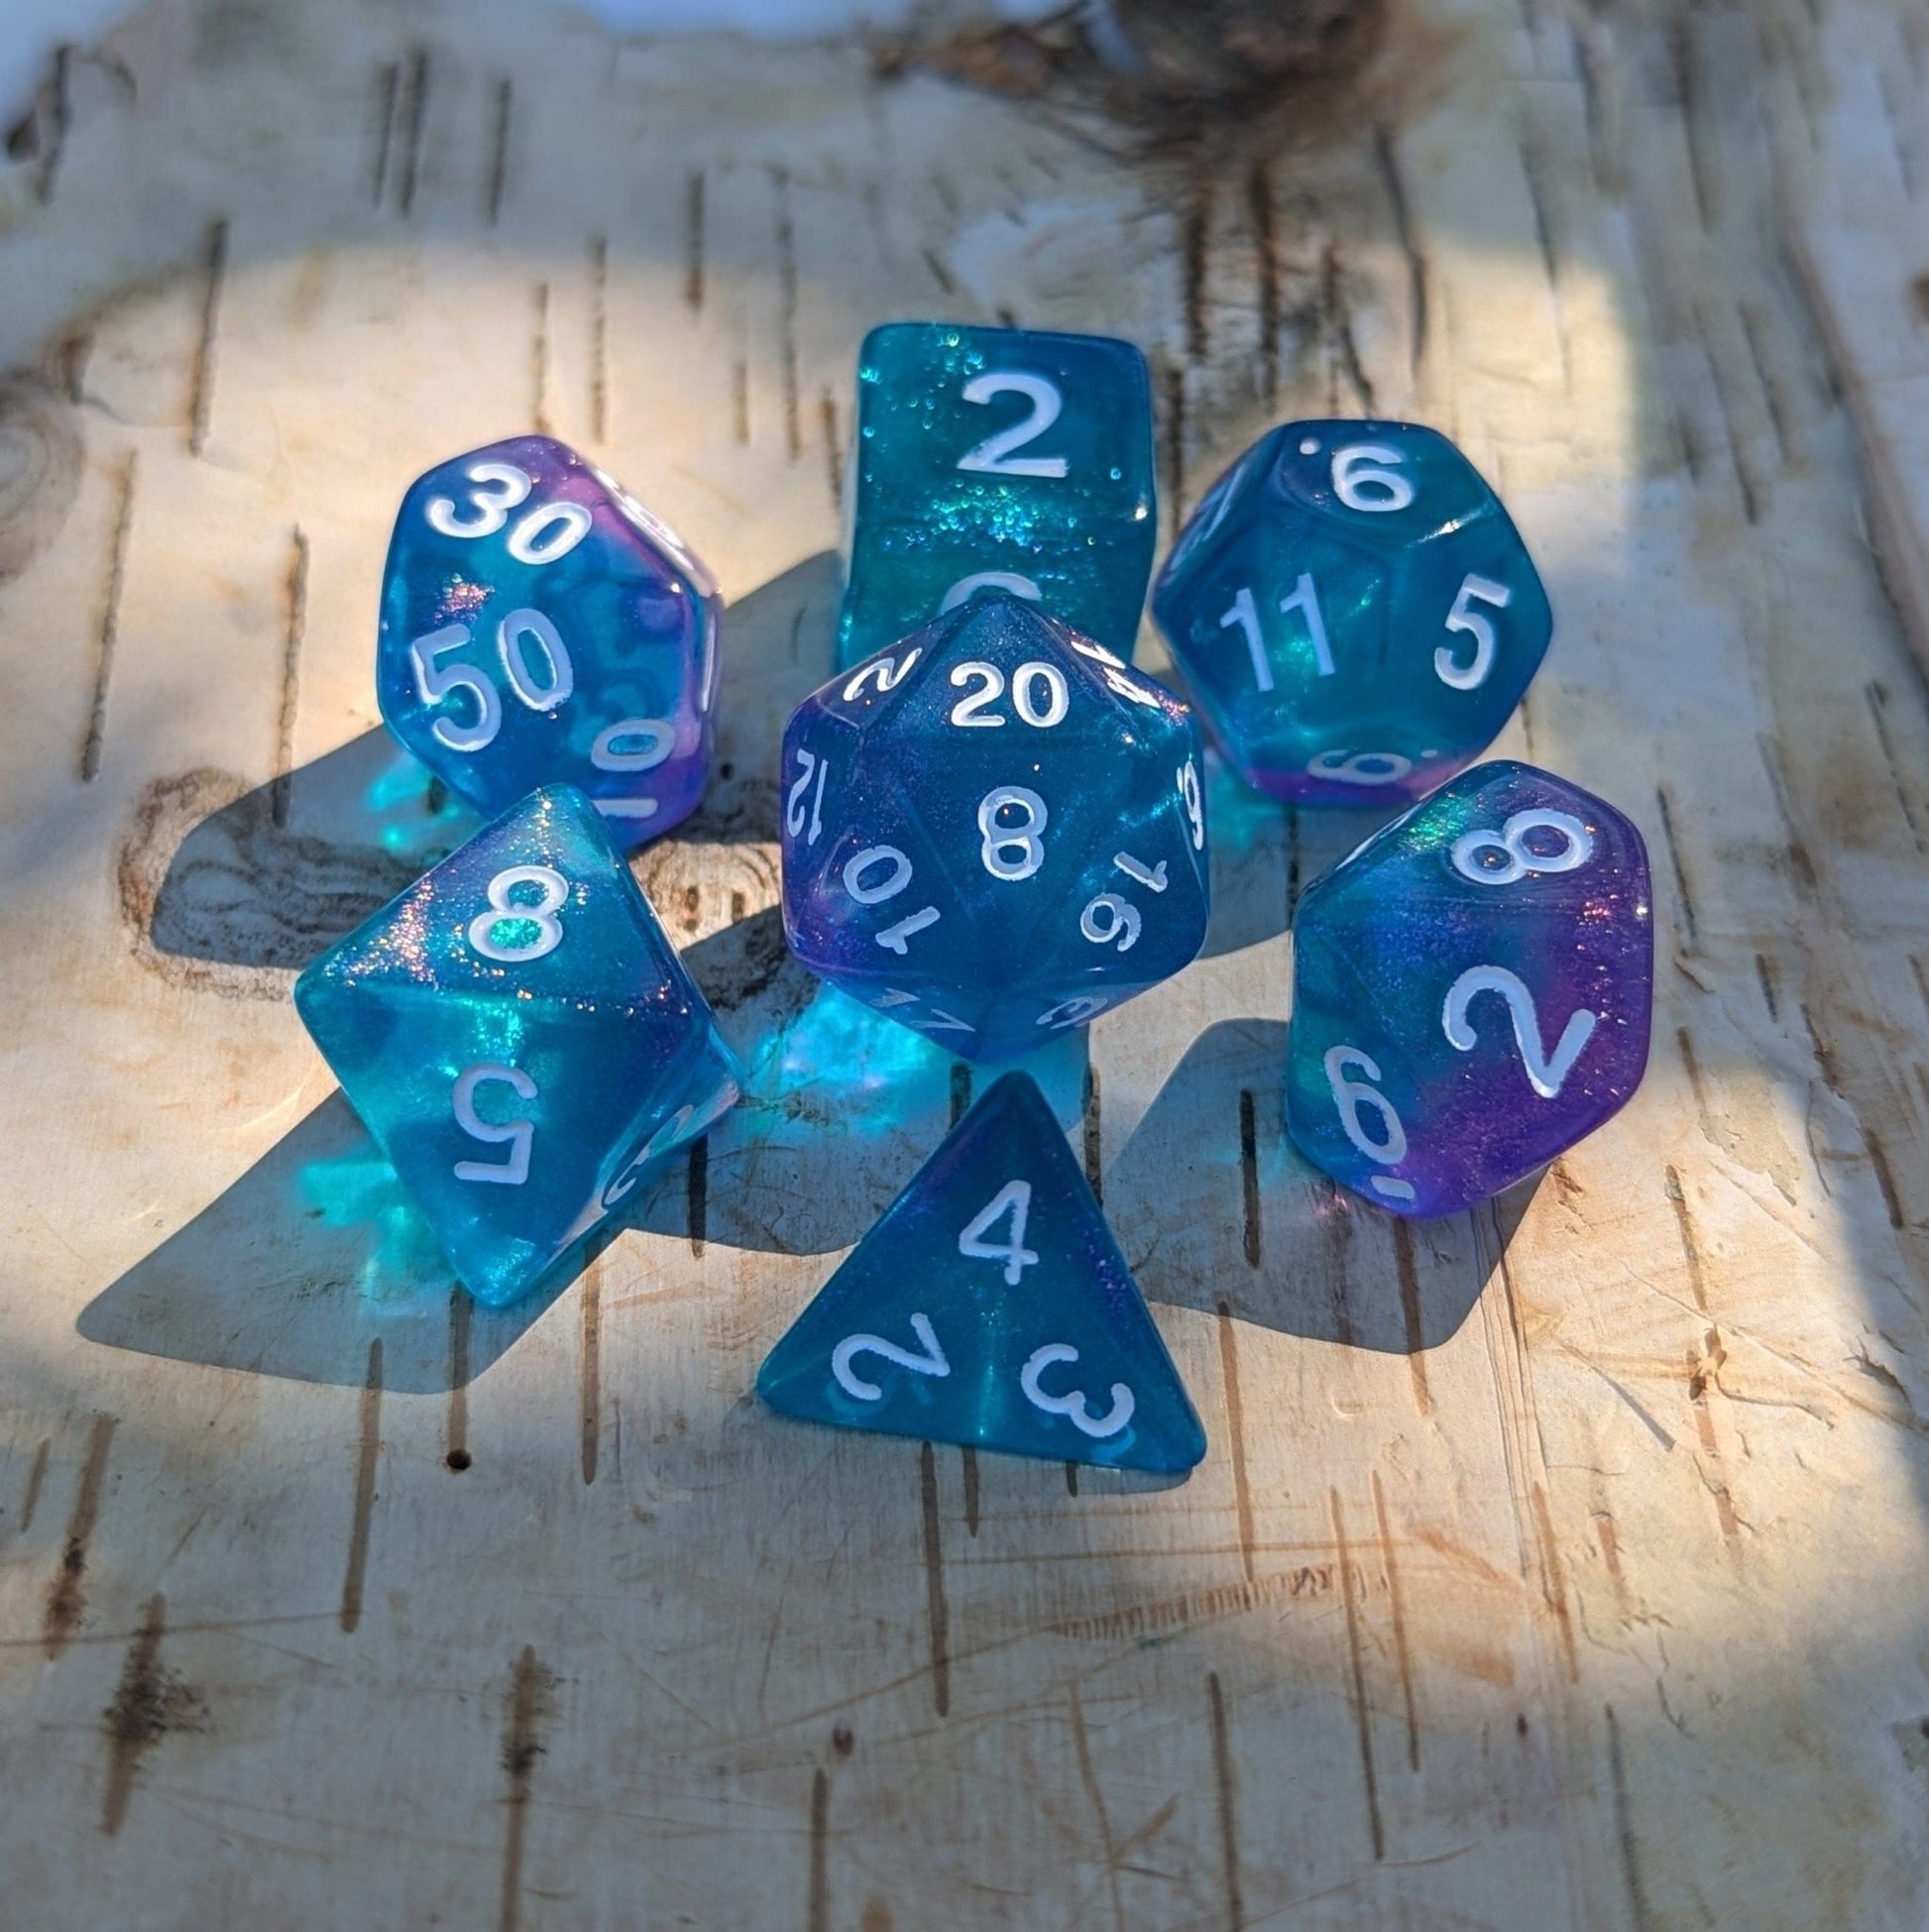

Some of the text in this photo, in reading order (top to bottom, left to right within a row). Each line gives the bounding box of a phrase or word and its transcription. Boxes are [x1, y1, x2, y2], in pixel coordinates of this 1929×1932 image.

[956, 373, 1071, 478] 2
[425, 463, 593, 565] 30
[411, 608, 574, 752] 50
[844, 647, 923, 702] 2
[1219, 572, 1336, 692] 11
[1433, 572, 1511, 691] 5
[950, 661, 1070, 728] 20
[787, 748, 829, 847] 12
[977, 785, 1048, 882] 8
[1449, 808, 1594, 885] 8
[468, 864, 569, 963] 8
[843, 844, 941, 956] 10
[1080, 851, 1168, 953] 16
[1441, 965, 1596, 1098] 2
[452, 1061, 538, 1186] 5
[959, 1180, 1039, 1286] 4
[831, 1312, 951, 1402] 2
[1020, 1342, 1136, 1438] 3
